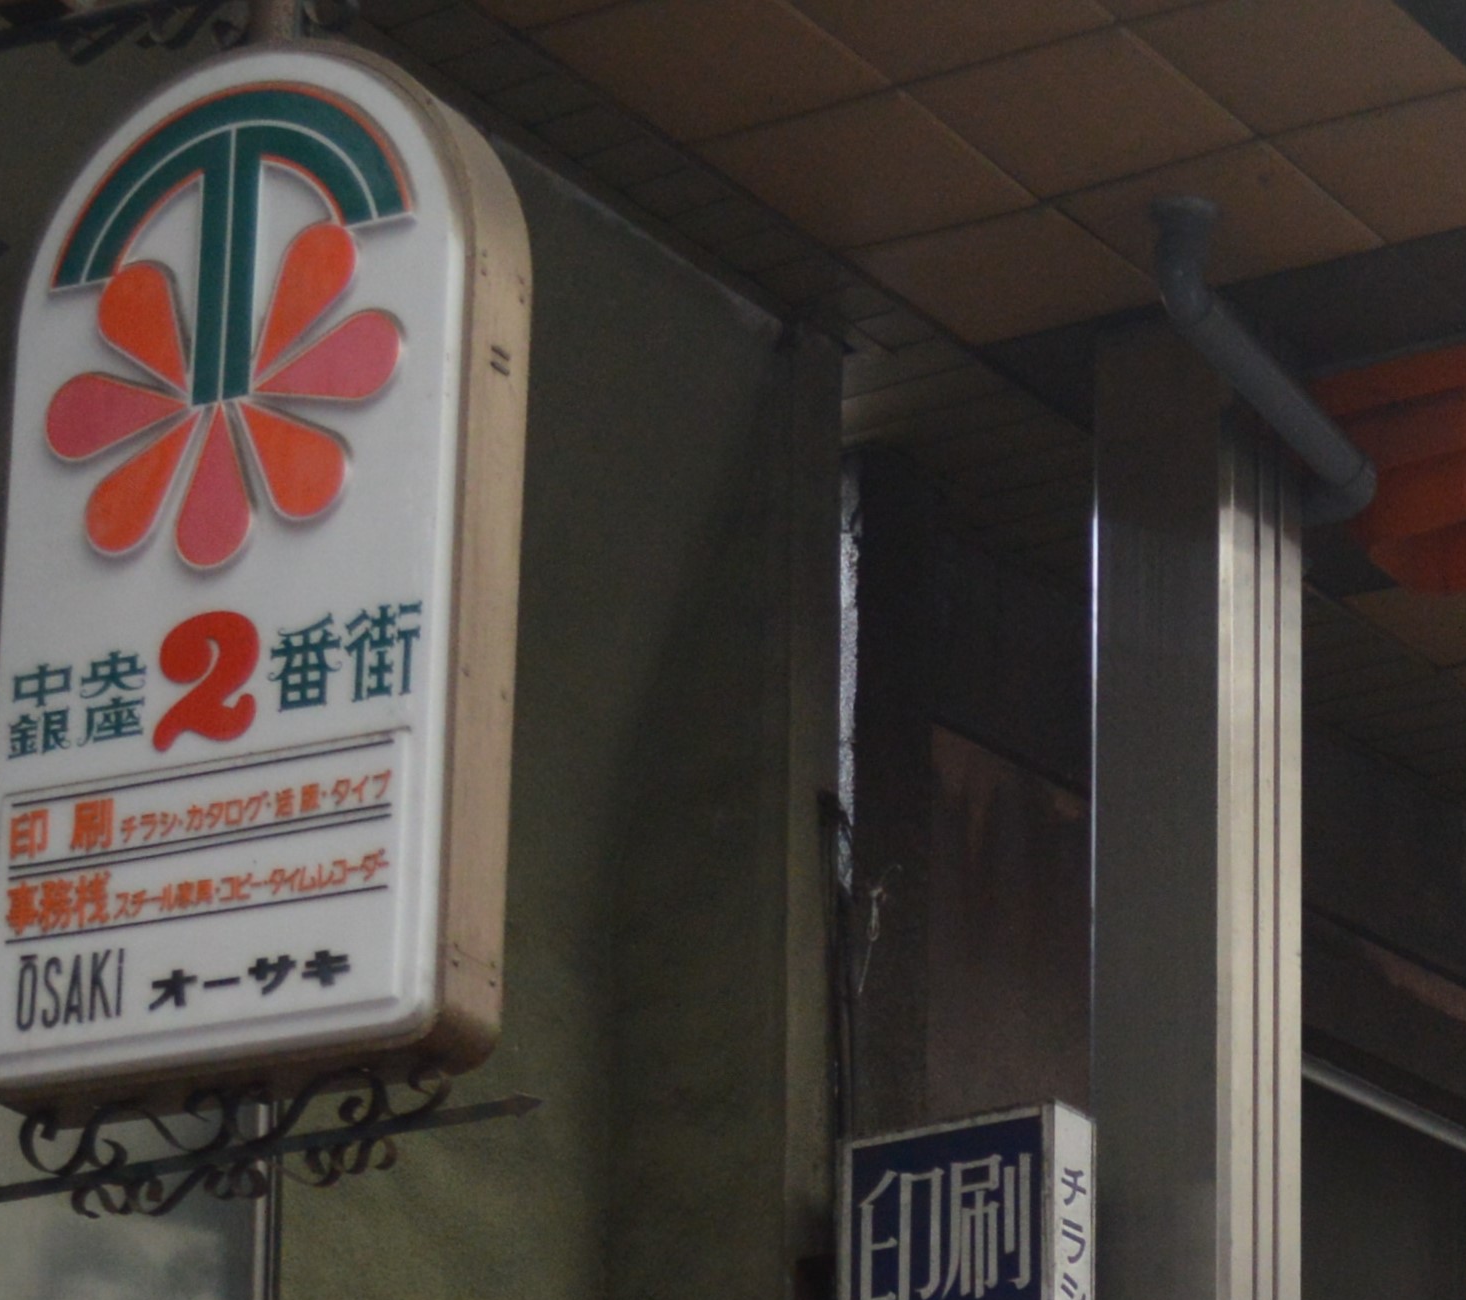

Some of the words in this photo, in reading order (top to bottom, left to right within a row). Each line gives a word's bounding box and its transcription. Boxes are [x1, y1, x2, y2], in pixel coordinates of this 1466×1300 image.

[12, 649, 147, 710] 中央
[7, 696, 147, 761] 銀座
[8, 798, 115, 860] 印刷
[147, 948, 352, 1013] オーサキ
